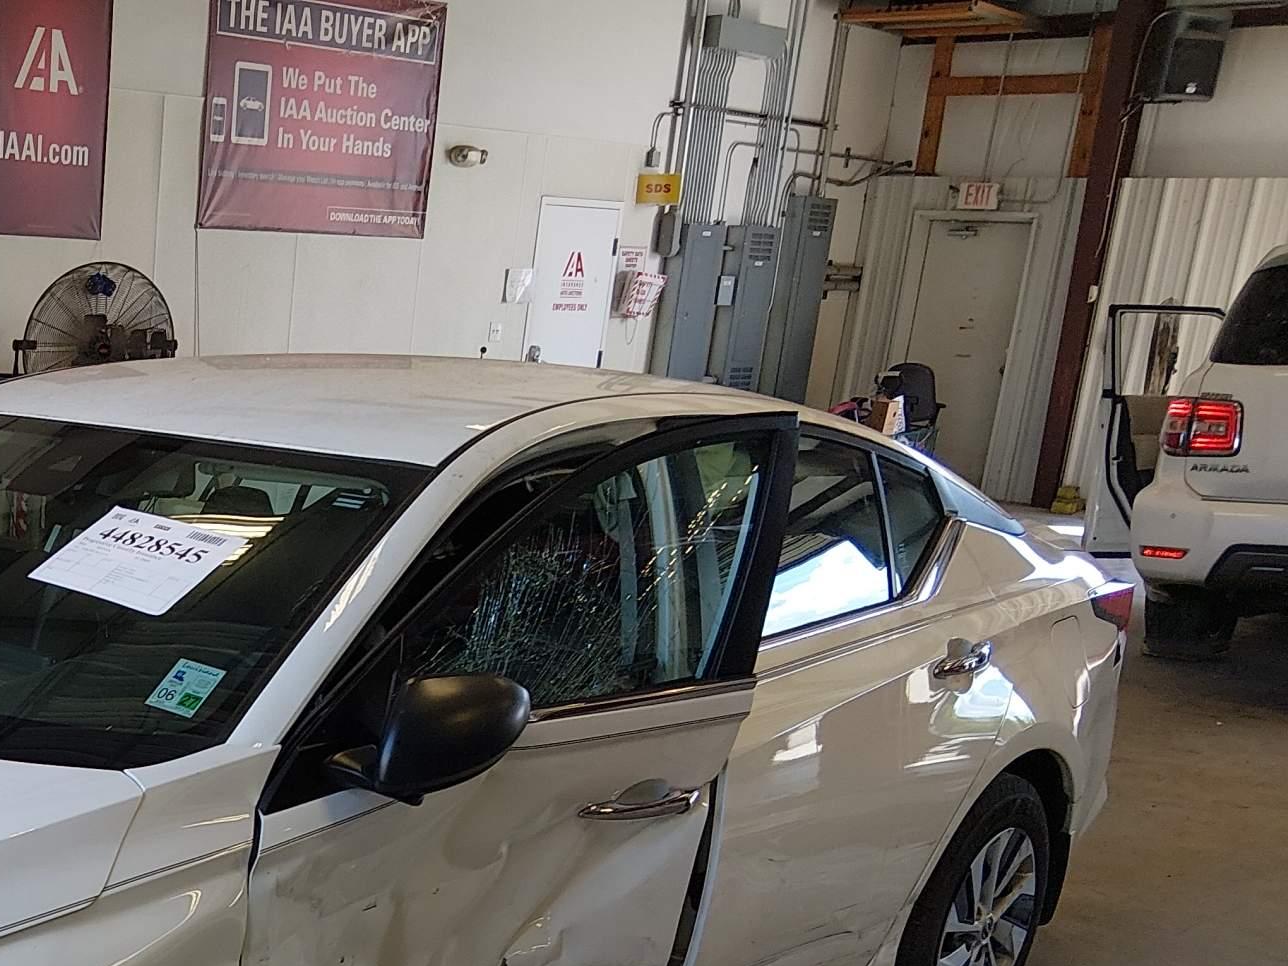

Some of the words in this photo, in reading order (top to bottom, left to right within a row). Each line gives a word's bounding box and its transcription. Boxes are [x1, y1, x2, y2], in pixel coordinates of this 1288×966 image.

[227, 0, 269, 32] THE
[275, 3, 312, 39] IAA
[319, 10, 387, 50] BUYER
[392, 22, 430, 55] APP
[282, 66, 308, 90] We
[314, 71, 343, 94] Put
[348, 75, 377, 98] The
[279, 97, 311, 120] IAA
[314, 101, 376, 127] Auction
[380, 109, 431, 133] Center
[277, 127, 294, 149] In
[300, 129, 337, 152] Your
[342, 134, 392, 158] Hands
[645, 183, 672, 193] SDS
[964, 184, 993, 207] EXIT
[383, 215, 397, 224] APP
[1190, 463, 1250, 474] ARMADA
[99, 527, 209, 565] 44828545
[157, 687, 177, 701] 06
[181, 695, 201, 709] 27
